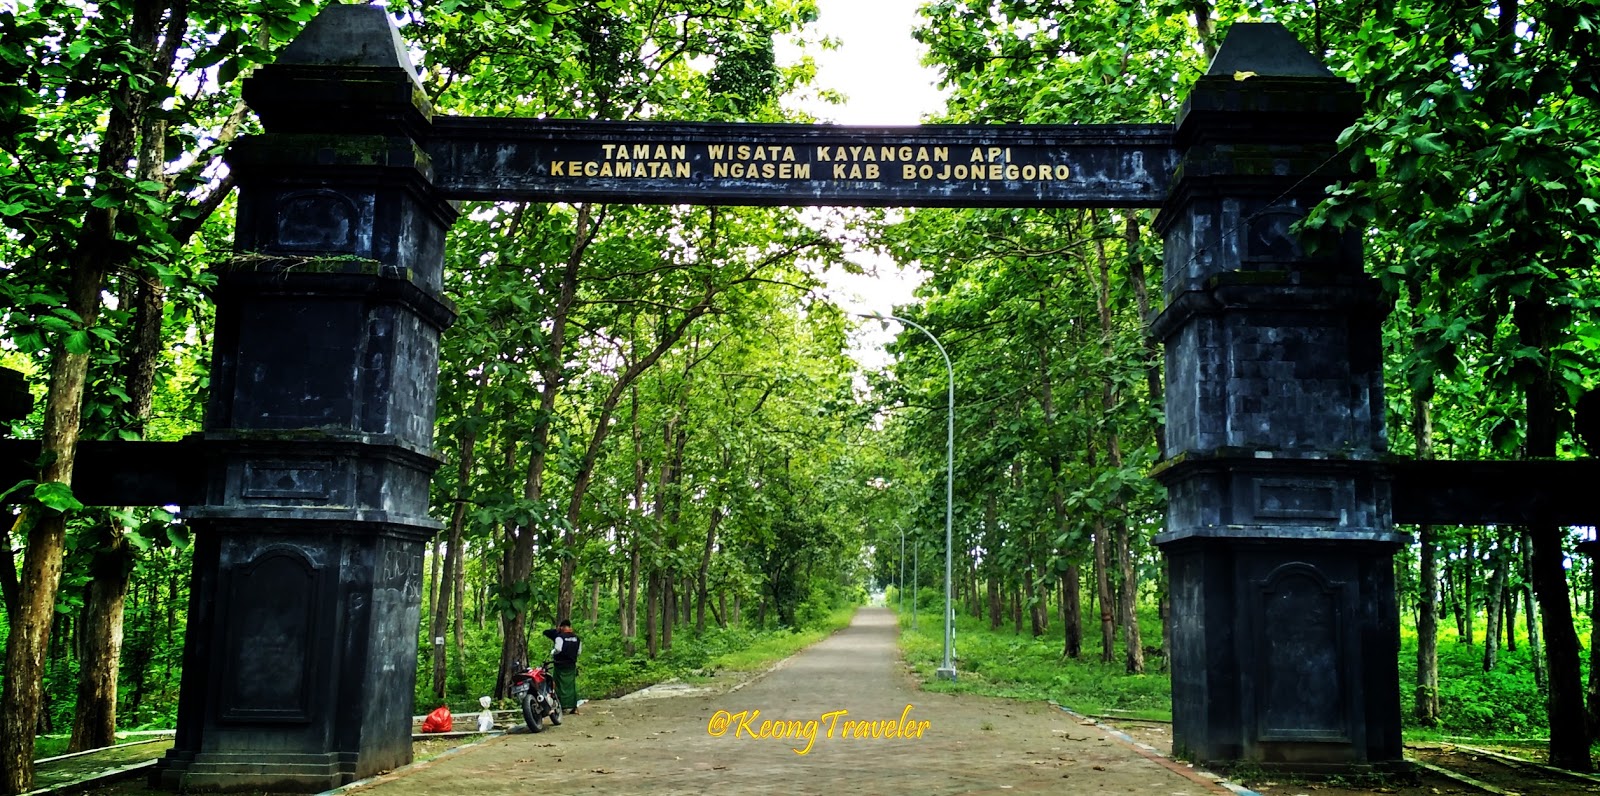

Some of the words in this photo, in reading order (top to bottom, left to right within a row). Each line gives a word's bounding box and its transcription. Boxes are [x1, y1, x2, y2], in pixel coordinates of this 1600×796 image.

[602, 144, 687, 160] TAMAN
[708, 144, 796, 161] WISATA
[816, 145, 949, 162] KAYANGAN
[970, 147, 1012, 163] API
[550, 160, 691, 178] KECAMATAN
[713, 162, 810, 179] NGASEM
[833, 164, 880, 180] KAB
[902, 164, 1070, 180] BOJONEGORO
